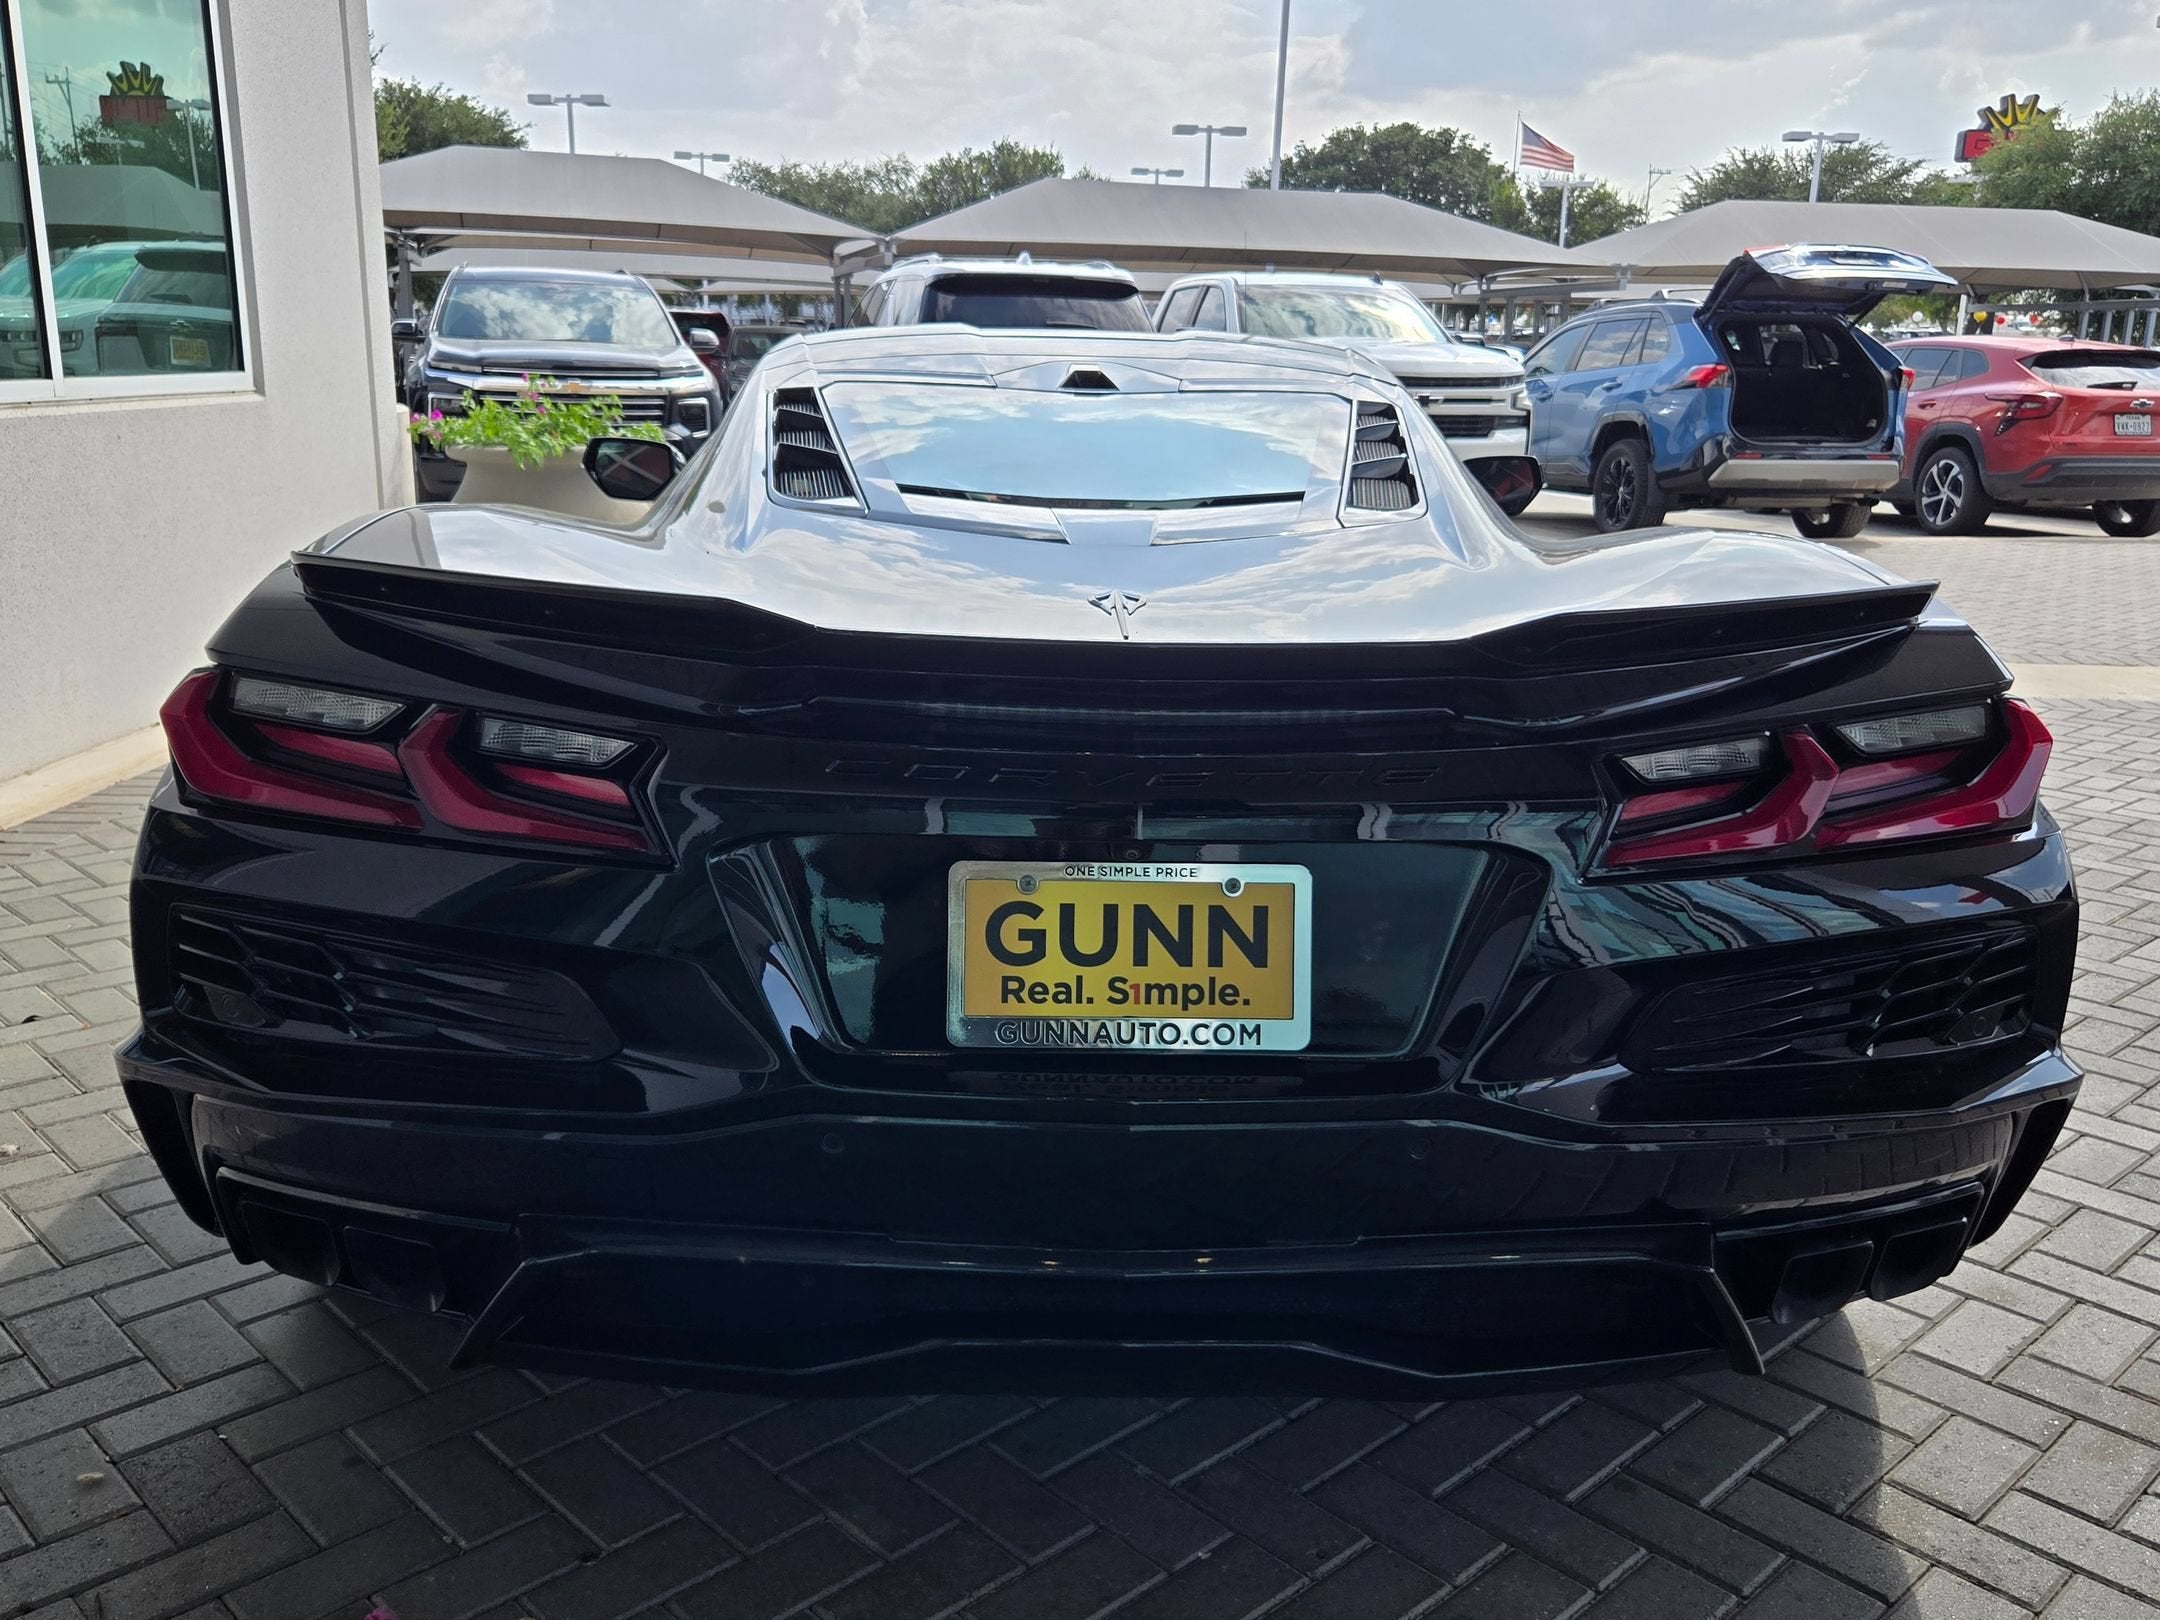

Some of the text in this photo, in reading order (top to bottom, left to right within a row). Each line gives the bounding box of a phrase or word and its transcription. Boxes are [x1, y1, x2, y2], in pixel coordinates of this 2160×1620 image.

[826, 758, 1441, 787] CORVETTE
[1064, 865, 1199, 878] ONE SIMPLE PRICE
[984, 900, 1270, 969] GUNN
[1000, 975, 1095, 1005] Real.
[995, 1022, 1262, 1047] GUNNAUTO.COM
